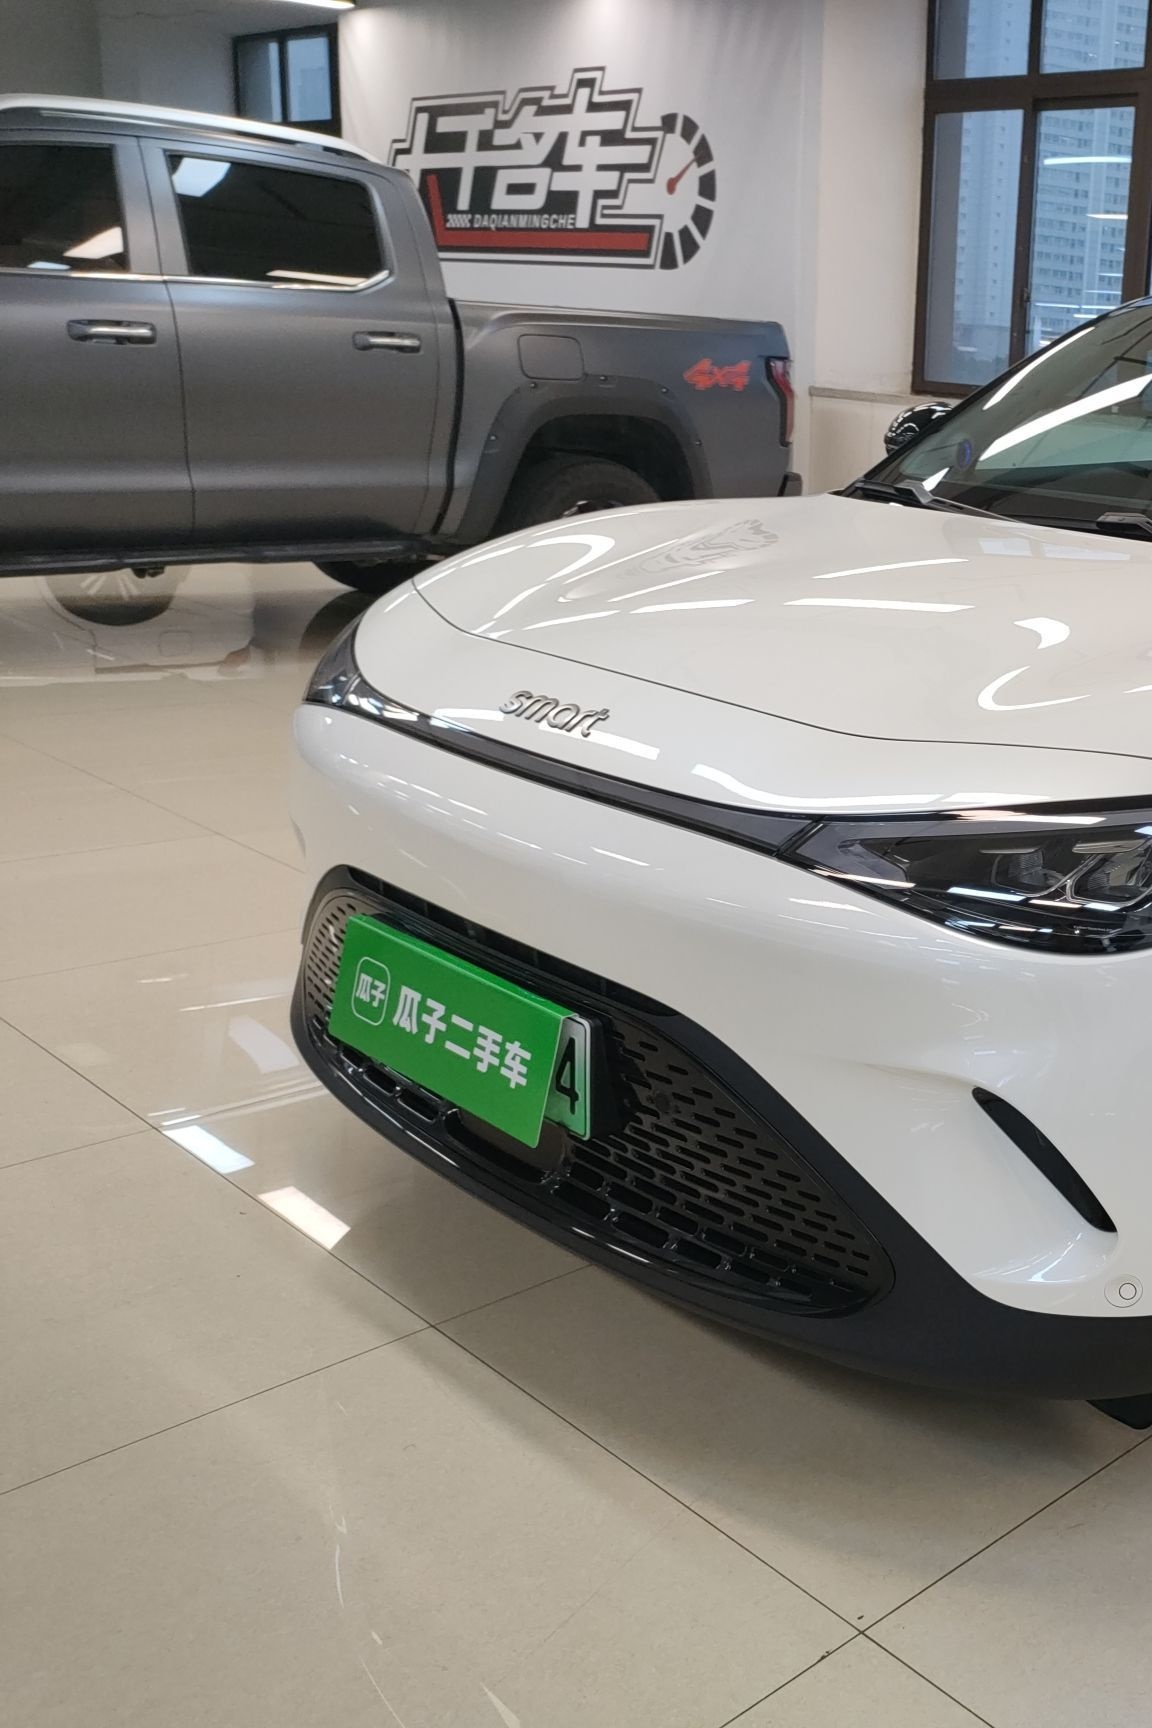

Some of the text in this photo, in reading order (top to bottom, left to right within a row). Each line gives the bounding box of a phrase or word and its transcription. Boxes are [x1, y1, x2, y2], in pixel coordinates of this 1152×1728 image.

[472, 213, 577, 231] DAQIANMINGCHE
[499, 690, 611, 738] smart
[355, 973, 387, 1008] 瓜子
[392, 984, 532, 1089] 瓜子二手车
[555, 1036, 580, 1116] 4
